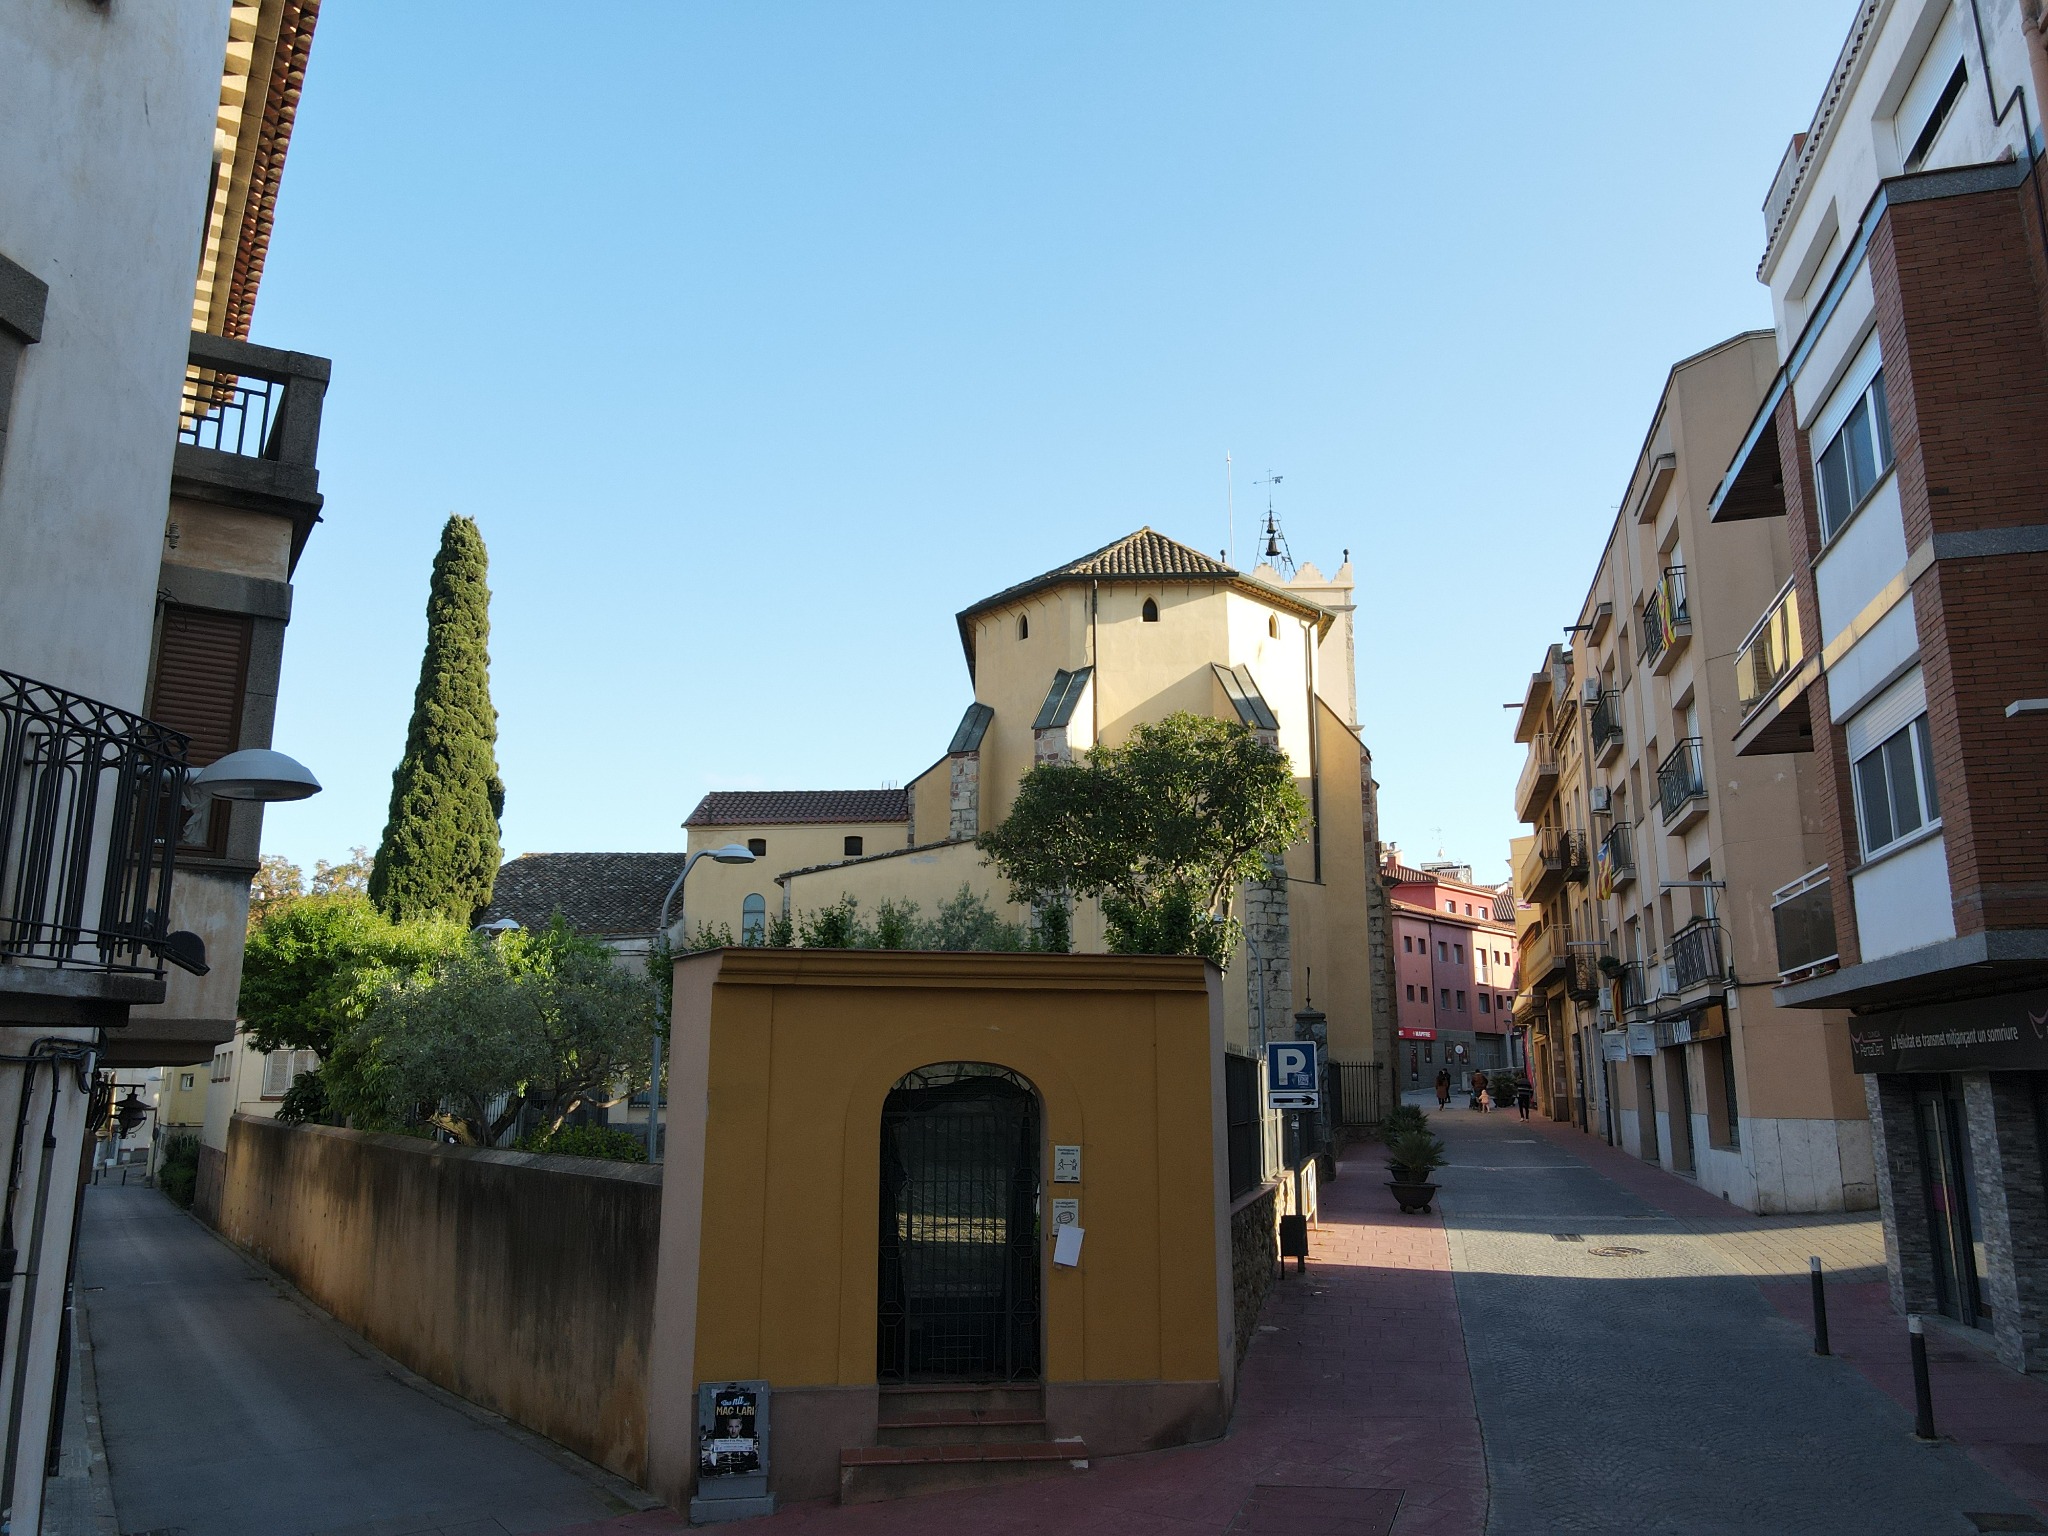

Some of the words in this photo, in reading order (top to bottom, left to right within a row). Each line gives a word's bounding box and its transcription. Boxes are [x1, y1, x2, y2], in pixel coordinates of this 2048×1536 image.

[1890, 1036, 1897, 1050] La
[1921, 1031, 1947, 1047] transmet
[1977, 1029, 1987, 1043] un
[1986, 1022, 2019, 1043] somriure
[1277, 1048, 1307, 1086] P
[736, 1406, 755, 1416] LARI
